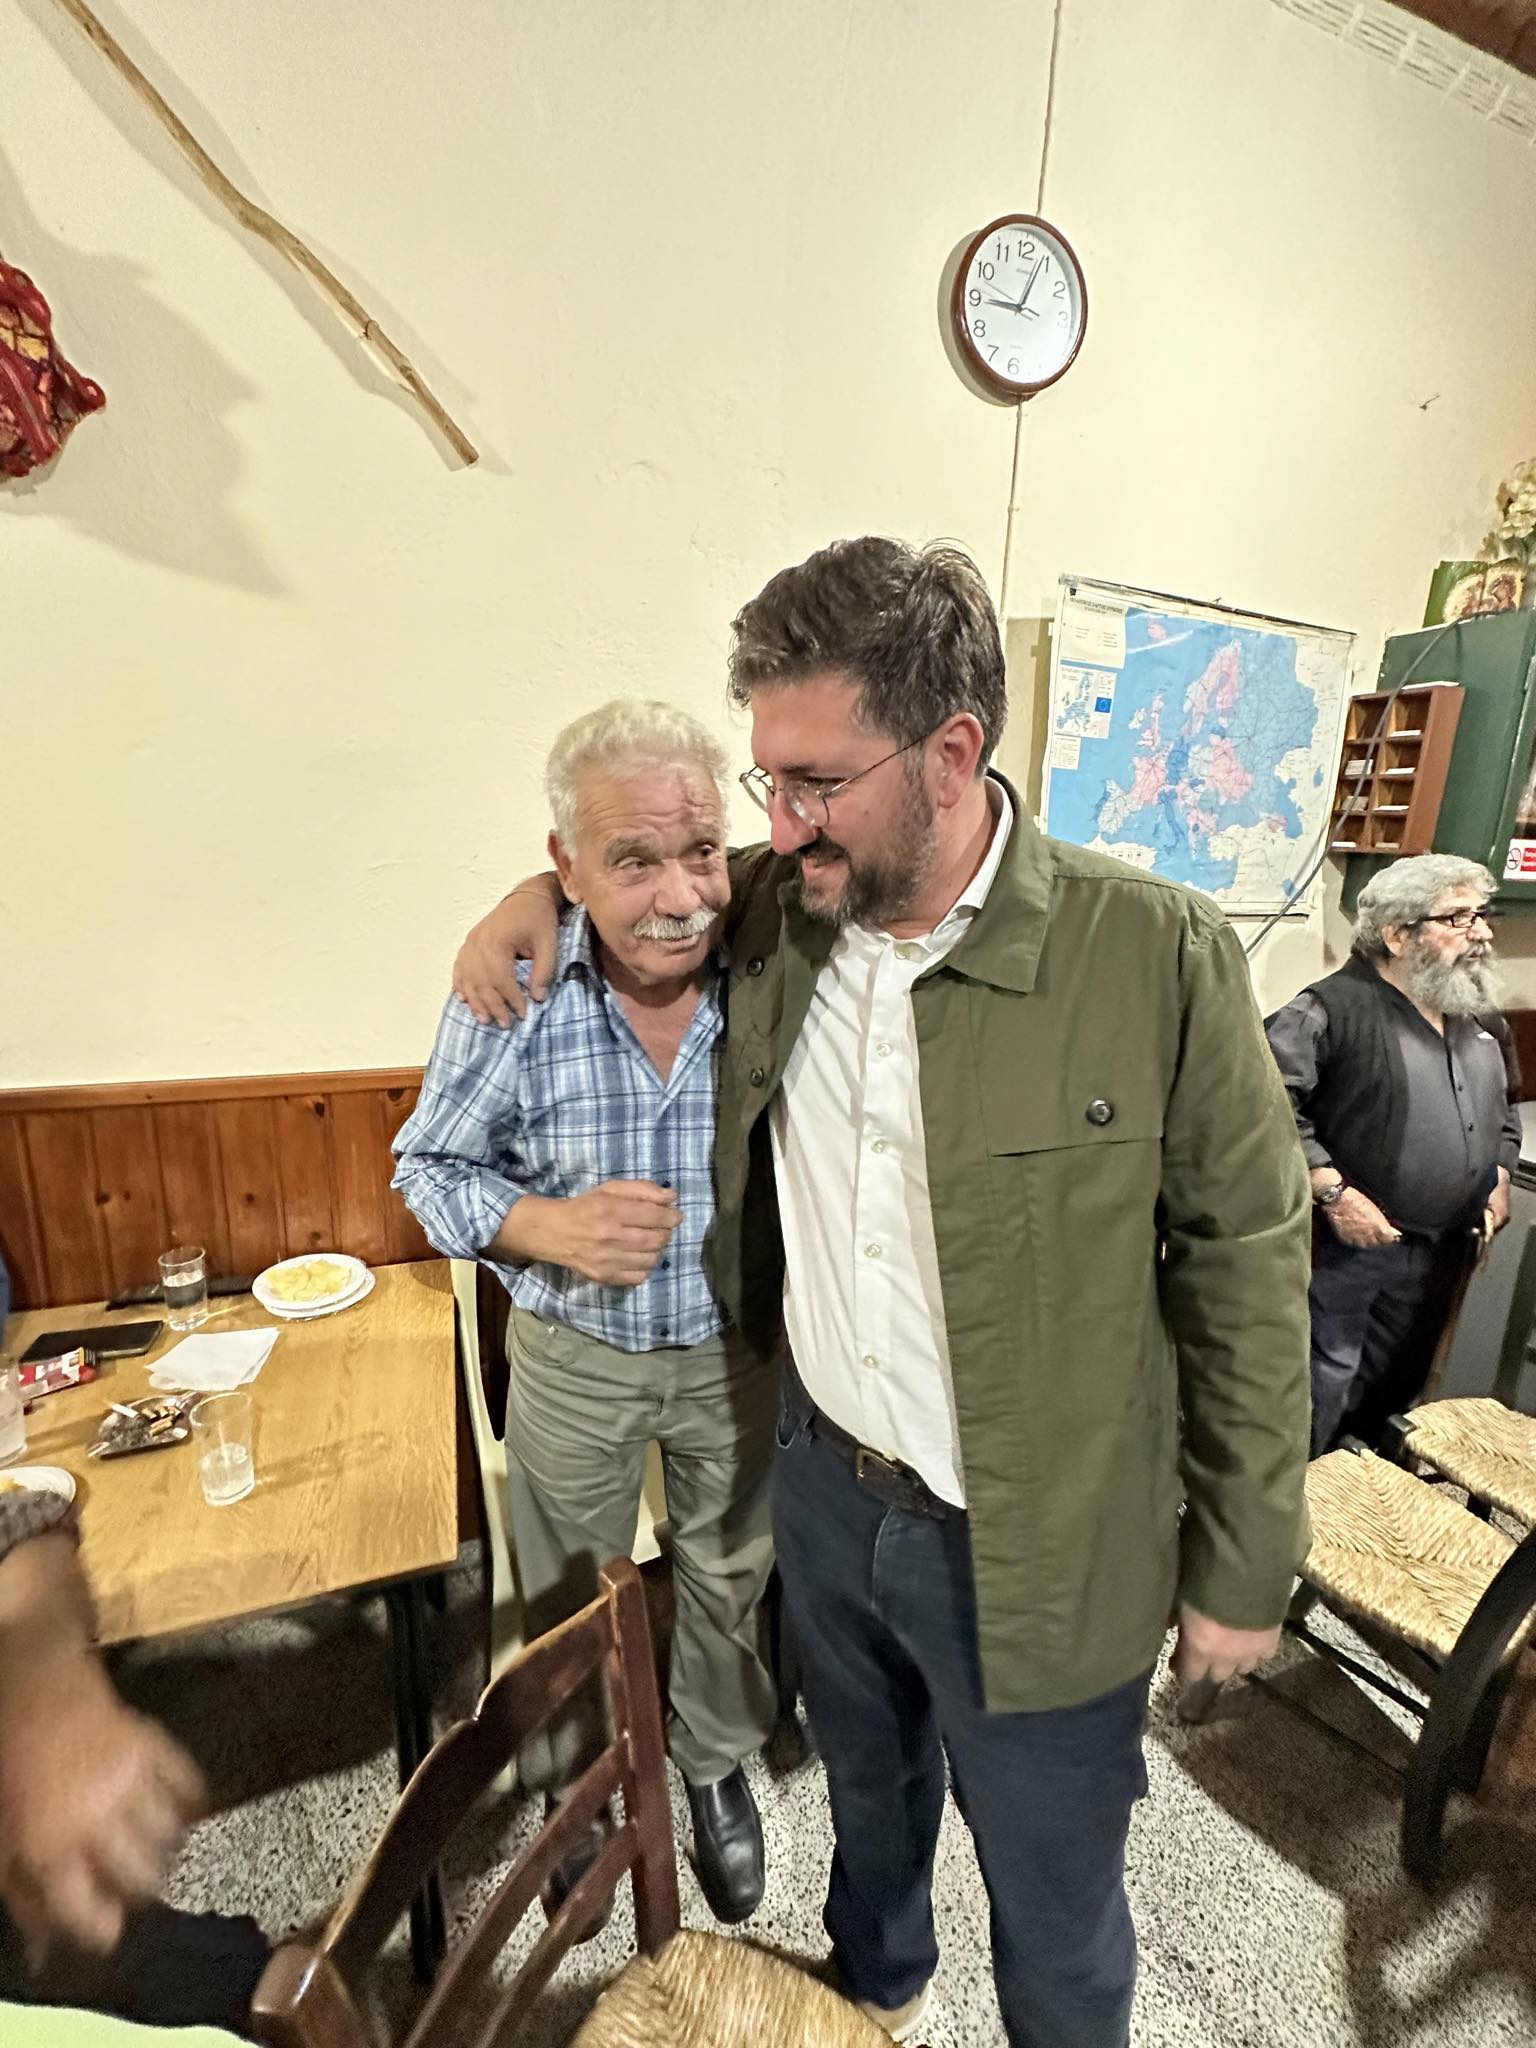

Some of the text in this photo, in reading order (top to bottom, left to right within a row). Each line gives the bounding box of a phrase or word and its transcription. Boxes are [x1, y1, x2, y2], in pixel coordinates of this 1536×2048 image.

[996, 242, 1010, 263] 11
[1018, 239, 1036, 261] 12
[977, 261, 995, 281] 10
[1045, 256, 1050, 273] 1
[969, 289, 982, 307] 9
[1053, 280, 1067, 300] 2
[1057, 310, 1068, 328] 3
[973, 319, 986, 338] 8
[987, 344, 1000, 362] 7
[1007, 357, 1020, 375] 6
